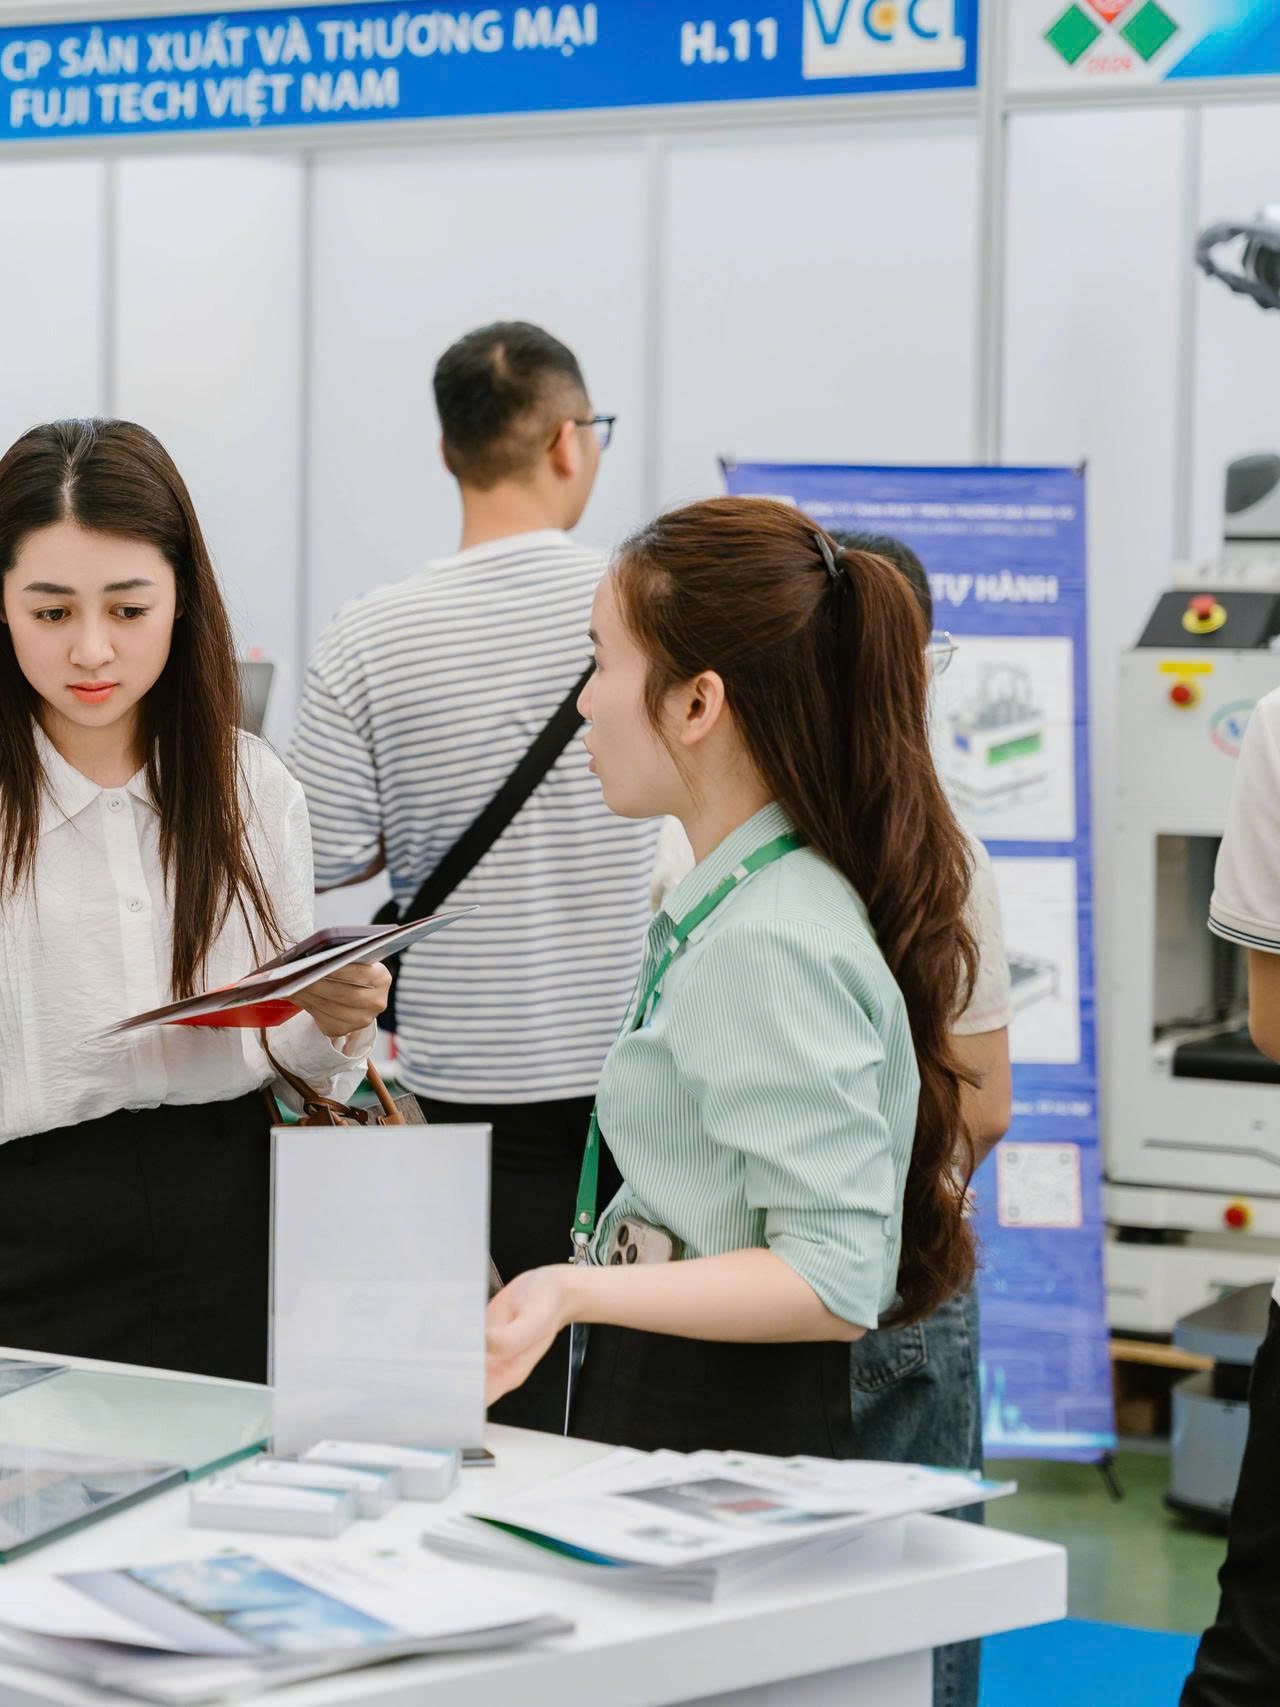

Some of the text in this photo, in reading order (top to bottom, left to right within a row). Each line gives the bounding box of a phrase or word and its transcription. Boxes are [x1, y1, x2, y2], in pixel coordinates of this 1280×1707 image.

[0, 37, 56, 81] CP
[257, 17, 311, 66] VÀ
[319, 11, 504, 61] THƯƠNG
[512, 3, 598, 58] MẠI
[680, 17, 778, 65] H.11
[10, 66, 400, 128] FUJI TECH VIỆT NAM
